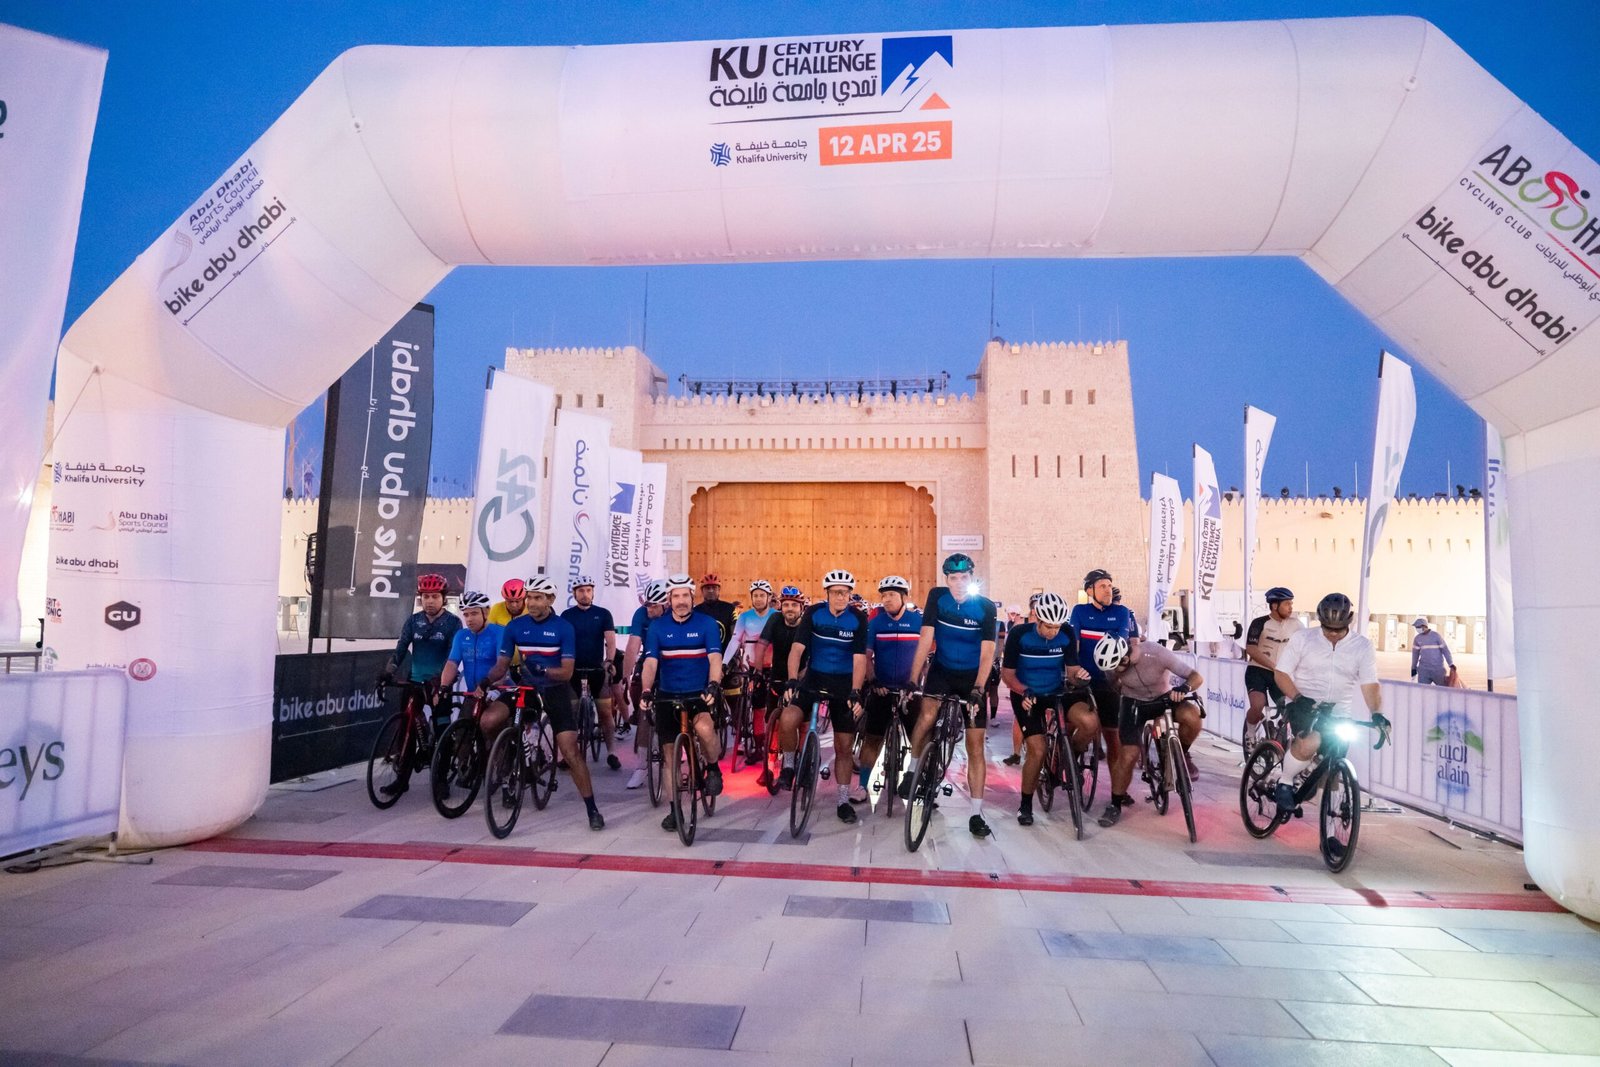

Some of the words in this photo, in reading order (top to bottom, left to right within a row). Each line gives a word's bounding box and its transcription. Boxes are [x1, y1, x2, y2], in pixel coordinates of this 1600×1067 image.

[774, 40, 865, 56] CENTURY
[709, 45, 768, 82] KU
[772, 52, 876, 76] CHALLENGE
[709, 82, 768, 109] خليفة
[772, 77, 828, 104] جامعة
[832, 76, 877, 106] تحدي
[829, 136, 854, 156] 12
[859, 134, 907, 155] APR
[912, 130, 942, 152] 25
[736, 153, 766, 164] Khalifa
[766, 151, 808, 163] University
[189, 199, 214, 226] Abu
[216, 158, 253, 198] Dhabi
[192, 202, 224, 235] Sports
[224, 167, 258, 204] Council
[1460, 178, 1504, 216] CYCLING
[1504, 216, 1532, 240] CLUB
[164, 279, 204, 315] bike
[203, 247, 236, 282] abu
[237, 196, 286, 249] dhabi
[1416, 206, 1464, 254] bike
[1462, 249, 1508, 289] abu
[1504, 288, 1577, 345] dhabi
[64, 474, 90, 483] Khalifa
[91, 475, 145, 487] University
[119, 512, 138, 520] Abu
[140, 512, 168, 520] Dhabi
[70, 558, 86, 566] abu
[88, 558, 118, 568] dhabi
[108, 610, 136, 622] GU
[280, 697, 314, 722] bike
[316, 692, 345, 716] abu
